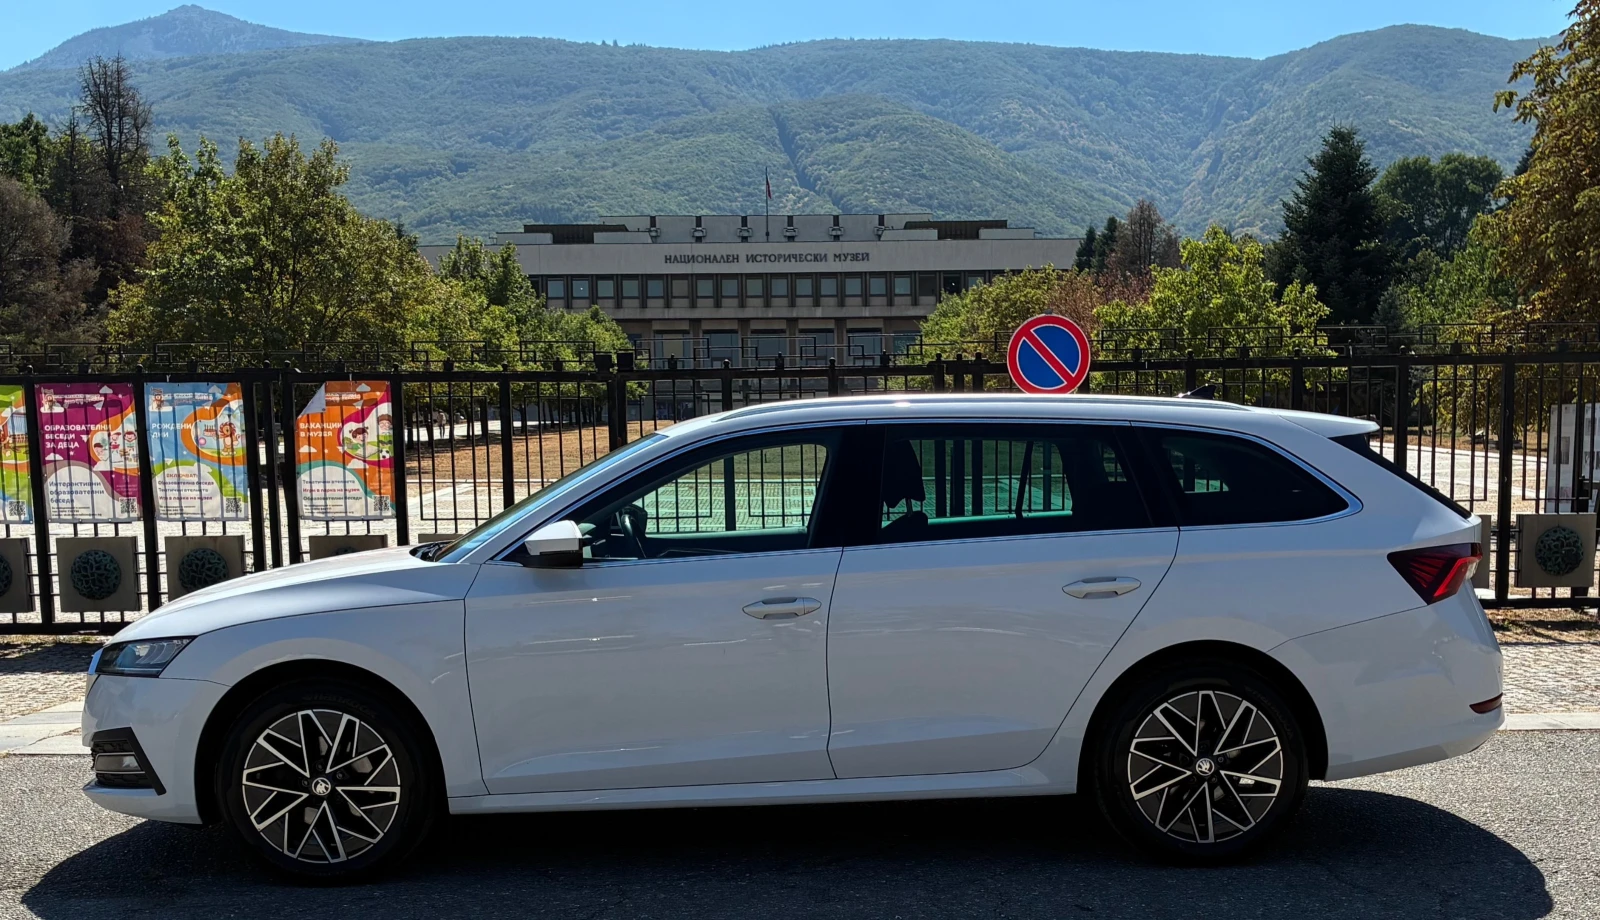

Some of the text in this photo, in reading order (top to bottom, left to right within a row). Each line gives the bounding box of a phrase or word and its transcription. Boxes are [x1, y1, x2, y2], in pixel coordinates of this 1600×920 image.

[664, 252, 870, 264] НАЦИОНАЛЕН ИСТОРИЧЕСКИ МУЗЕЙ
[299, 422, 343, 430] ВАКАНЦИИ
[57, 441, 80, 449] ДЕЦА
